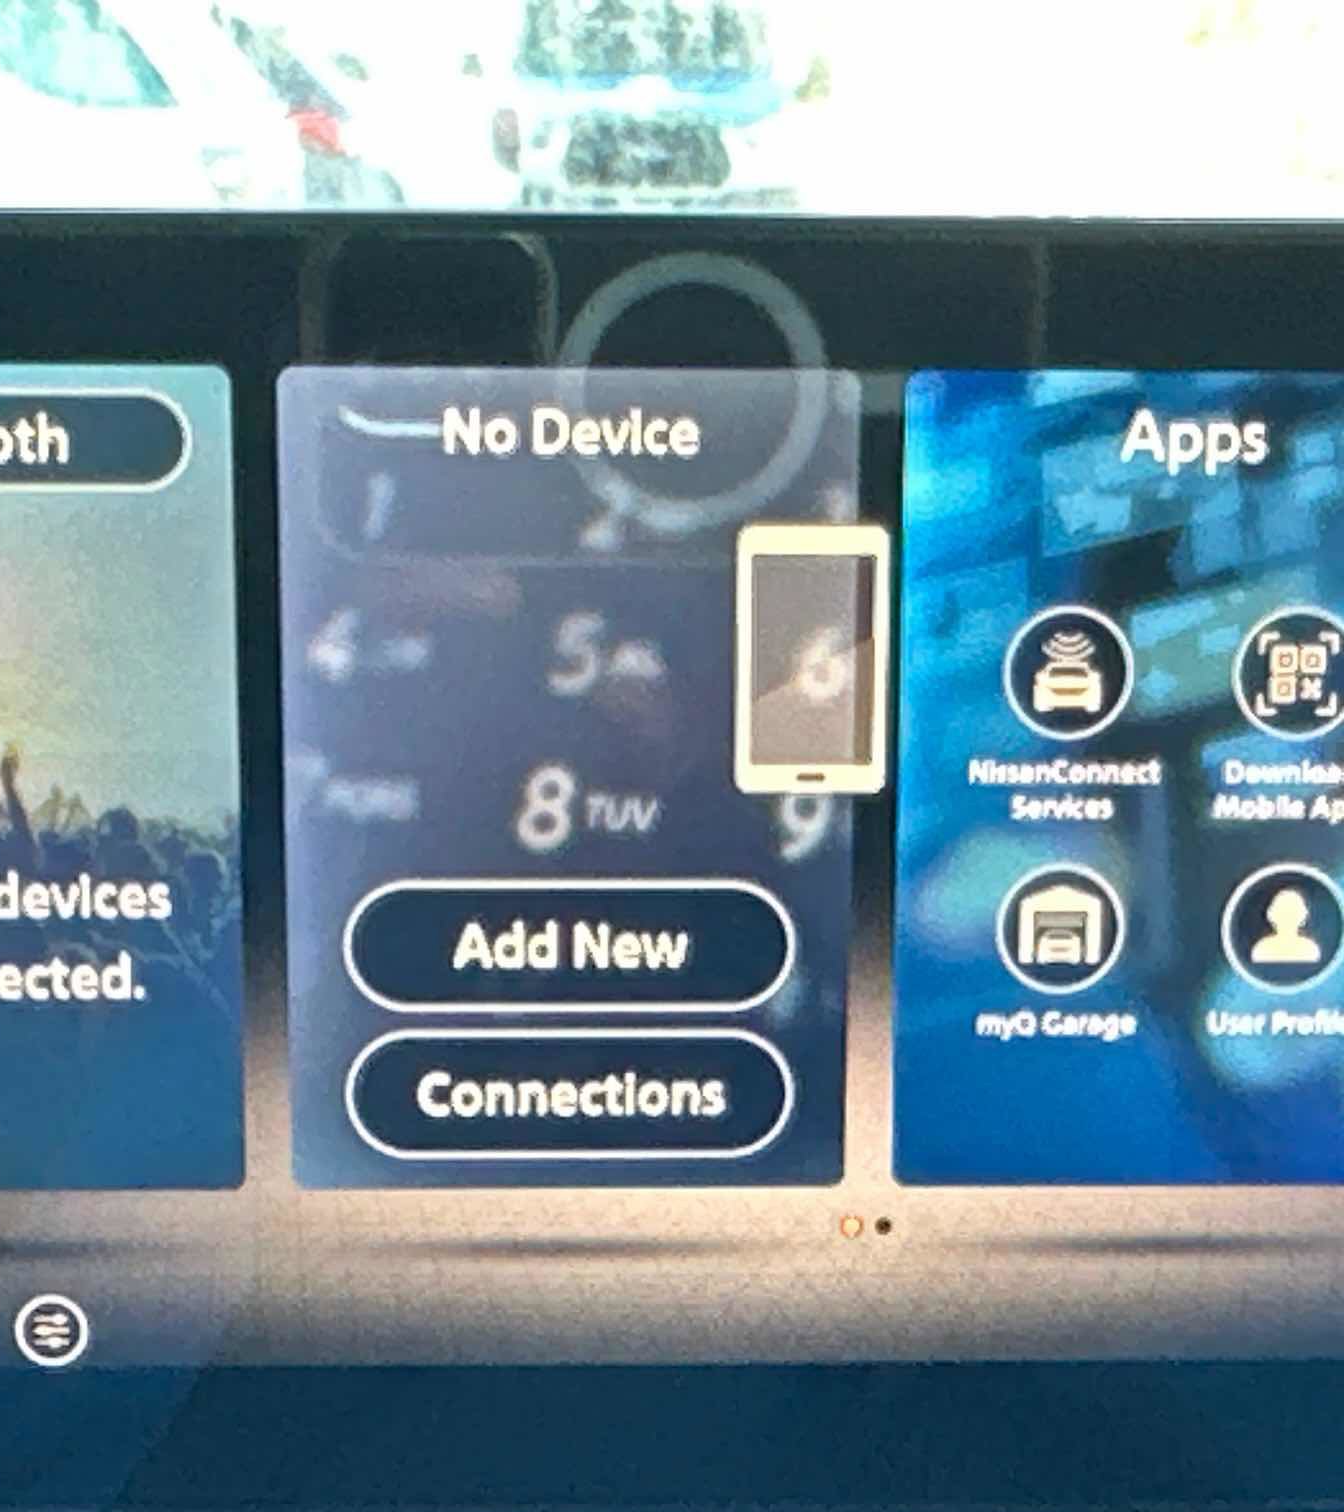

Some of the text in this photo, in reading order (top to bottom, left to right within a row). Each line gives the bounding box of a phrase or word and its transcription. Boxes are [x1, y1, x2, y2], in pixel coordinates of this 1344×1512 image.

[442, 407, 700, 455] No Device
[1120, 408, 1269, 476] Apps
[968, 760, 1161, 785] NissanConnect
[1011, 795, 1114, 820] Services
[1212, 795, 1305, 820] Mobile
[454, 921, 688, 970] Add New
[975, 1011, 1136, 1042] myQ Garage
[1207, 1011, 1266, 1035] User
[416, 1071, 726, 1119] Connections
